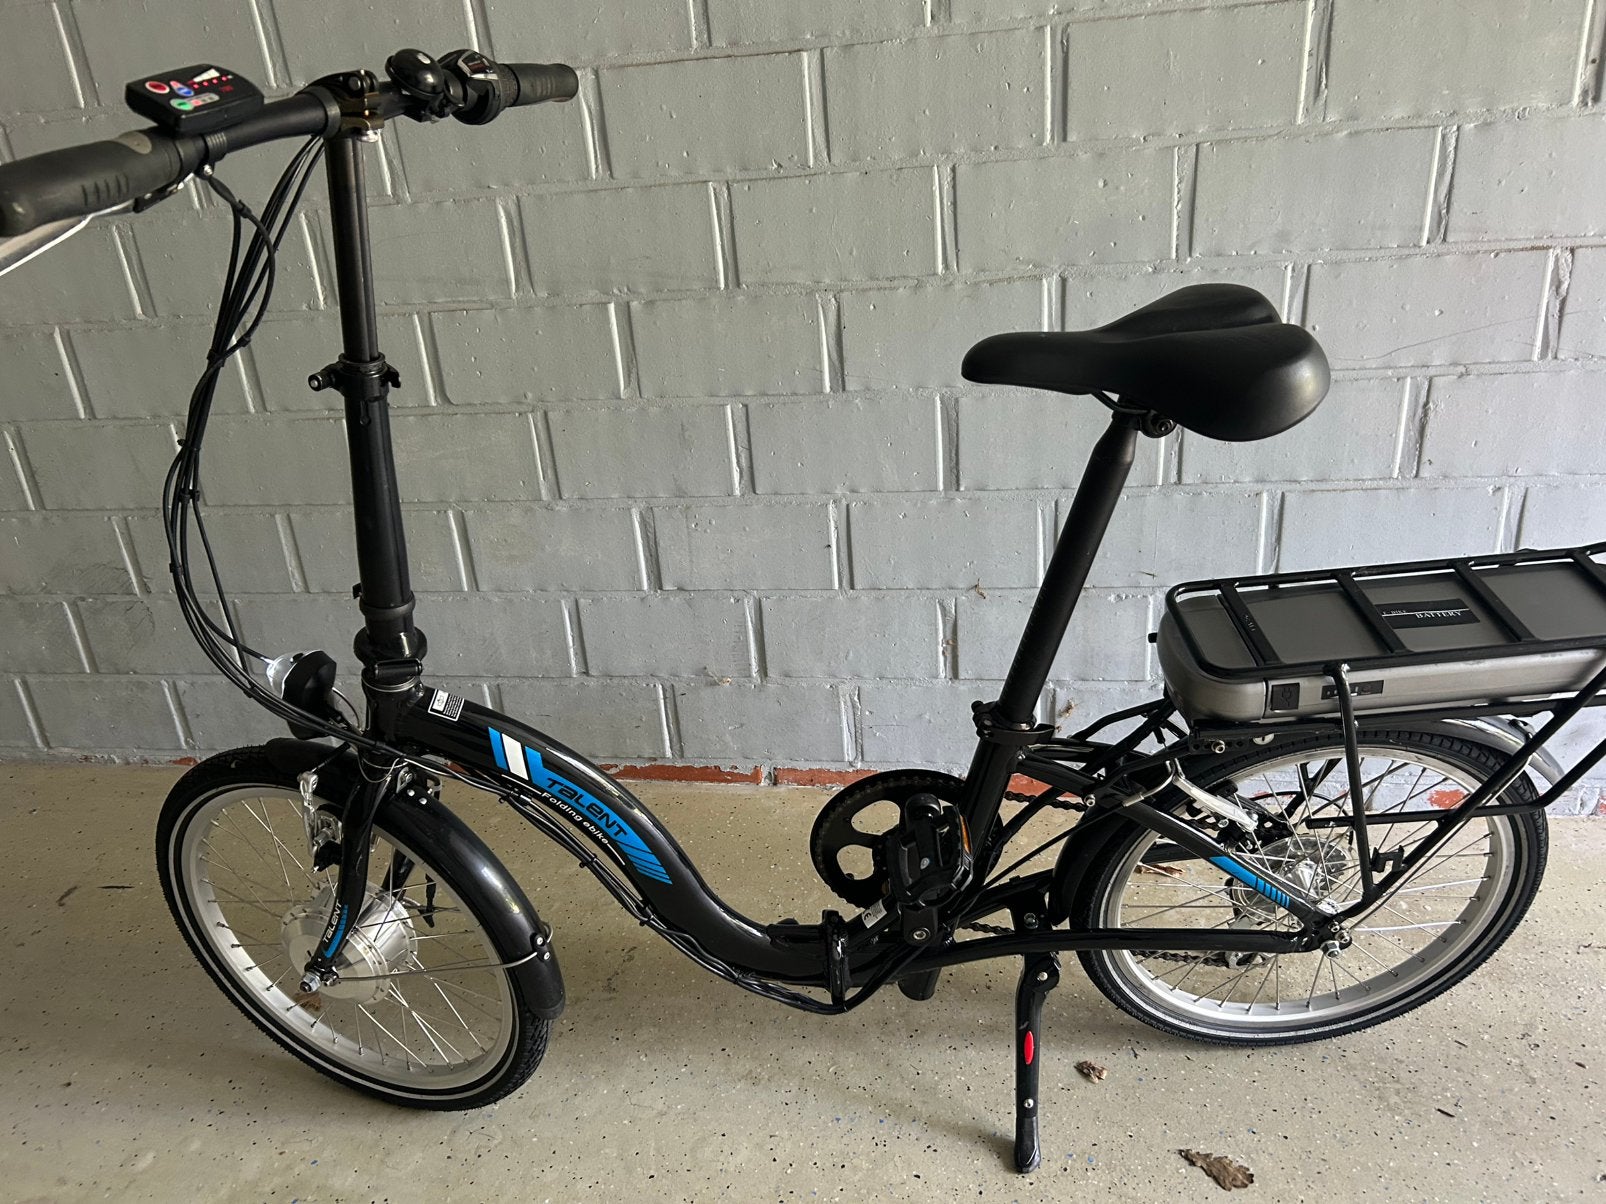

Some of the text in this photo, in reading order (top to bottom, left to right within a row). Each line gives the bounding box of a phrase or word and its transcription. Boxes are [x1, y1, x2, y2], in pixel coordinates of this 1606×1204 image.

[1415, 611, 1461, 619] BATTERY
[541, 791, 609, 844] Folding ebike
